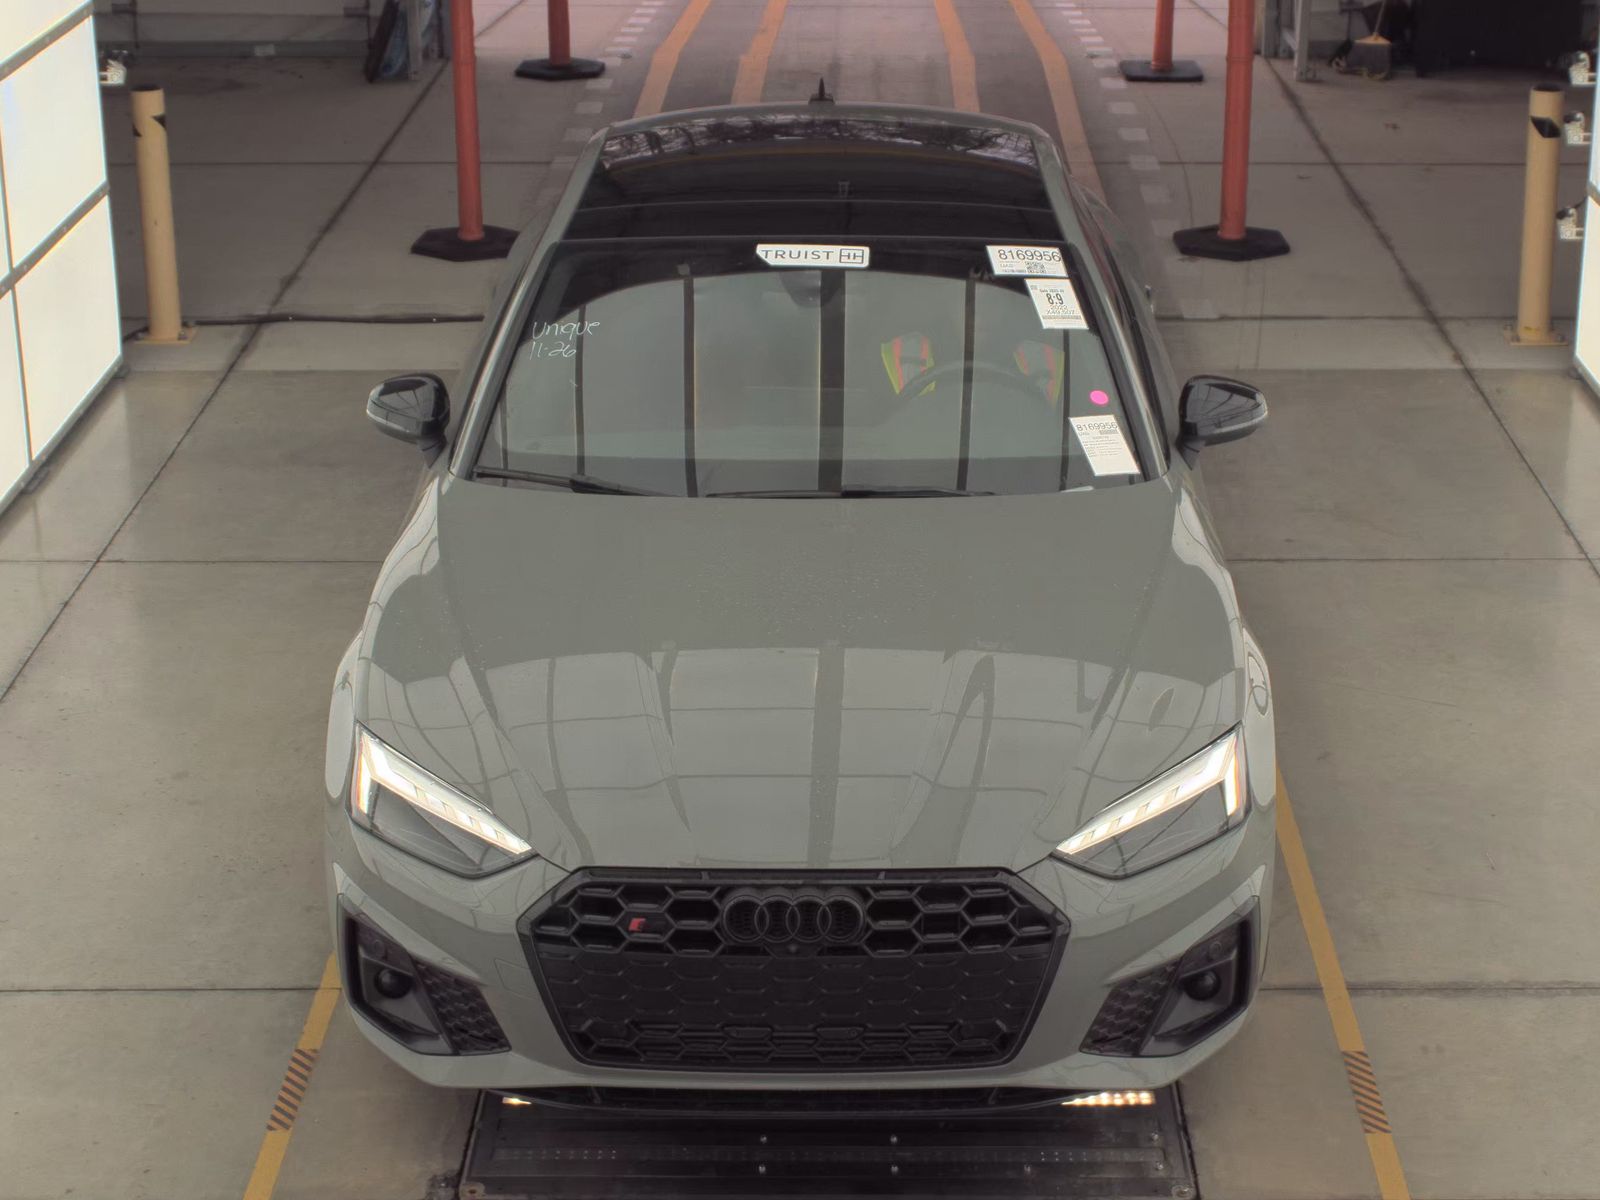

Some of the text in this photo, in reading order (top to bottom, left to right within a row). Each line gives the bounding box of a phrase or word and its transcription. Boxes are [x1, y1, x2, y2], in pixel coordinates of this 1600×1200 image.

[761, 249, 834, 260] TRUIST
[997, 249, 1062, 262] 8169956
[1045, 293, 1064, 305] 8:9
[1076, 422, 1118, 431] 8169956
